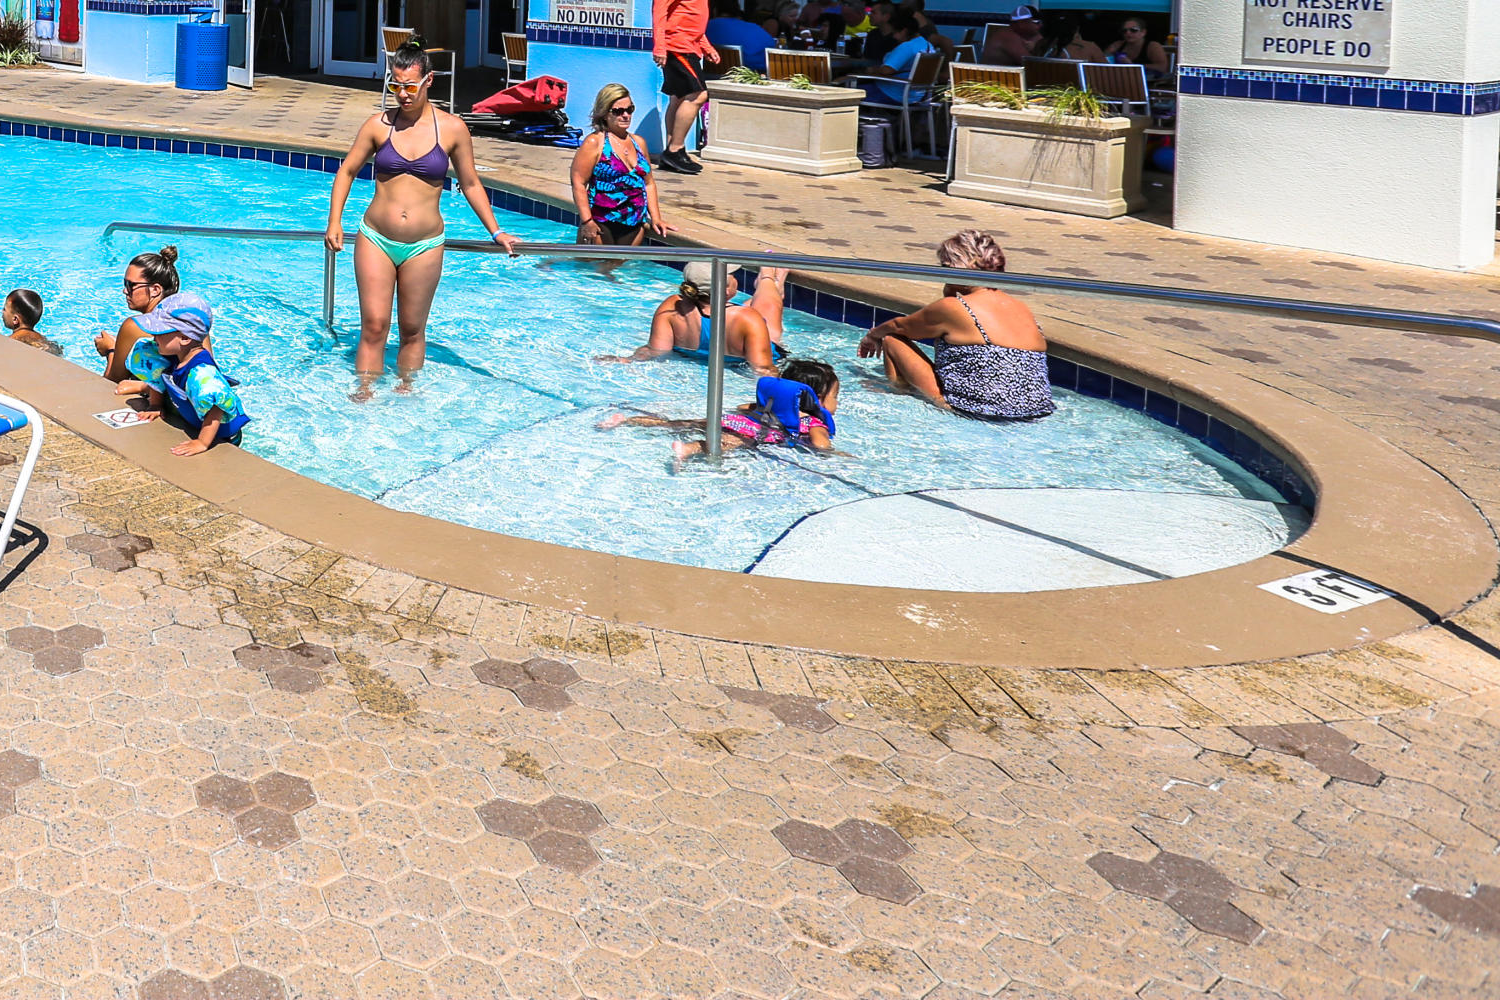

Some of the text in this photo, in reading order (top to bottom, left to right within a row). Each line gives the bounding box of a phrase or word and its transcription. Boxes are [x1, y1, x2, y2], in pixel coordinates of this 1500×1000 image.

[557, 9, 625, 26] NO DIVING
[1283, 11, 1353, 29] CHAIRS
[1263, 37, 1371, 58] PEOPLE DO
[1282, 573, 1384, 606] 3 FT
